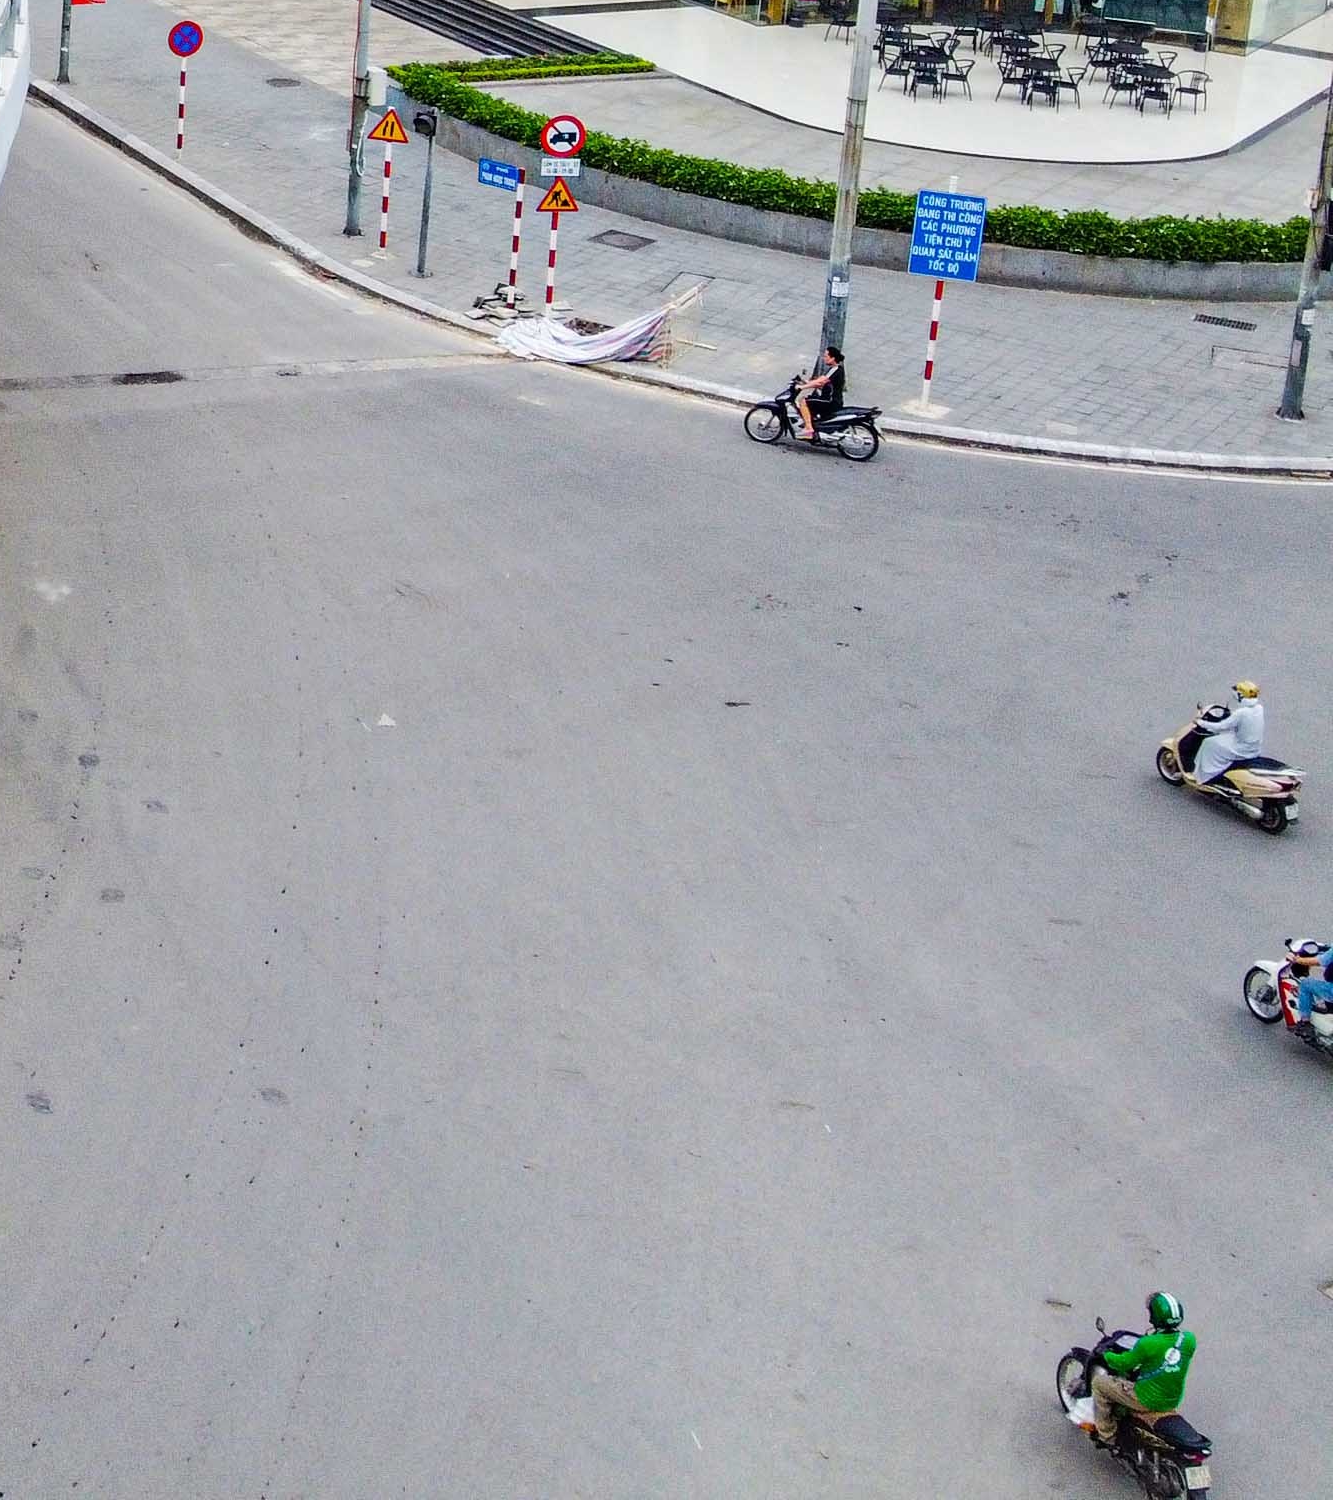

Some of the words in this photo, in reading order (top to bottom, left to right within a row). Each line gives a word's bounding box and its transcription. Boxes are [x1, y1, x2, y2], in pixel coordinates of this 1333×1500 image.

[923, 195, 947, 207] CÔNG
[950, 199, 983, 212] TRƯỜNG
[918, 208, 941, 219] ĐANG
[943, 211, 956, 221] THI
[959, 212, 982, 224] CÔNG
[921, 220, 938, 231] CÁC
[941, 223, 976, 236] PHƯƠNG
[924, 234, 943, 246] TIỆN
[913, 246, 935, 257] QUAN
[955, 250, 977, 263] GIẢM
[928, 259, 945, 271] TỐC
